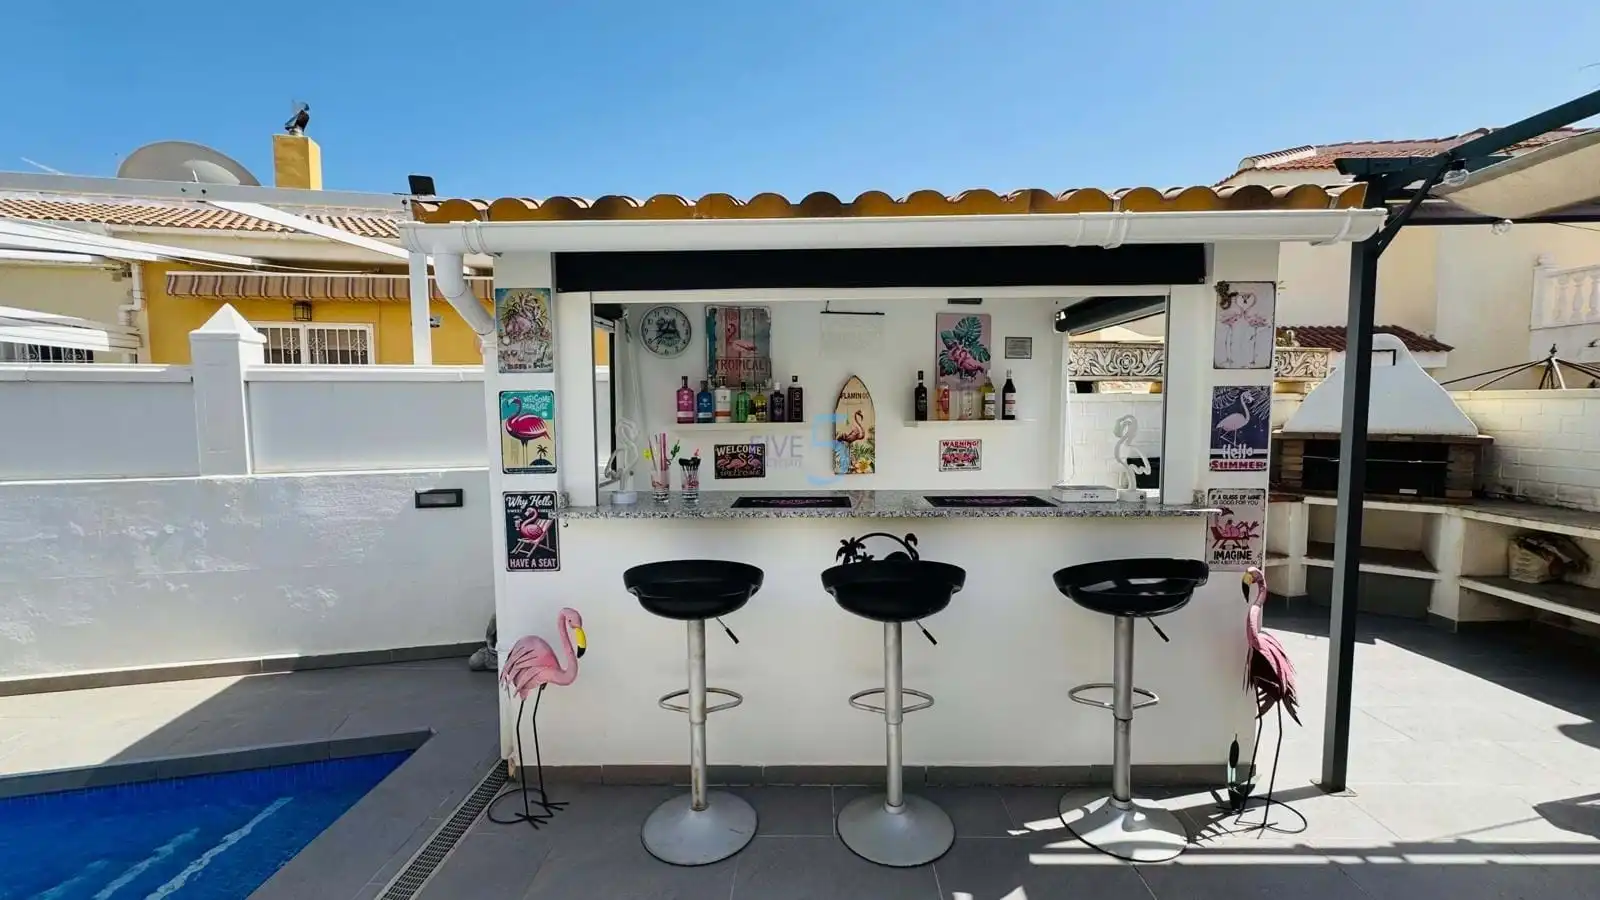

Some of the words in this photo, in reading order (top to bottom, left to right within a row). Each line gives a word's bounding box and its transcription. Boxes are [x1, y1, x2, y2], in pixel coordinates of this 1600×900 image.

[716, 359, 765, 370] TROPICAL
[942, 440, 979, 448] WARNING!
[716, 445, 763, 457] WELCOME
[1222, 443, 1253, 459] Hello
[1211, 460, 1264, 469] SUMMER
[506, 495, 528, 509] Why
[529, 495, 553, 507] Hello
[1213, 550, 1253, 560] IMAGINE
[510, 558, 530, 568] HAVE
[531, 558, 537, 568] A
[538, 558, 556, 567] SEAT
